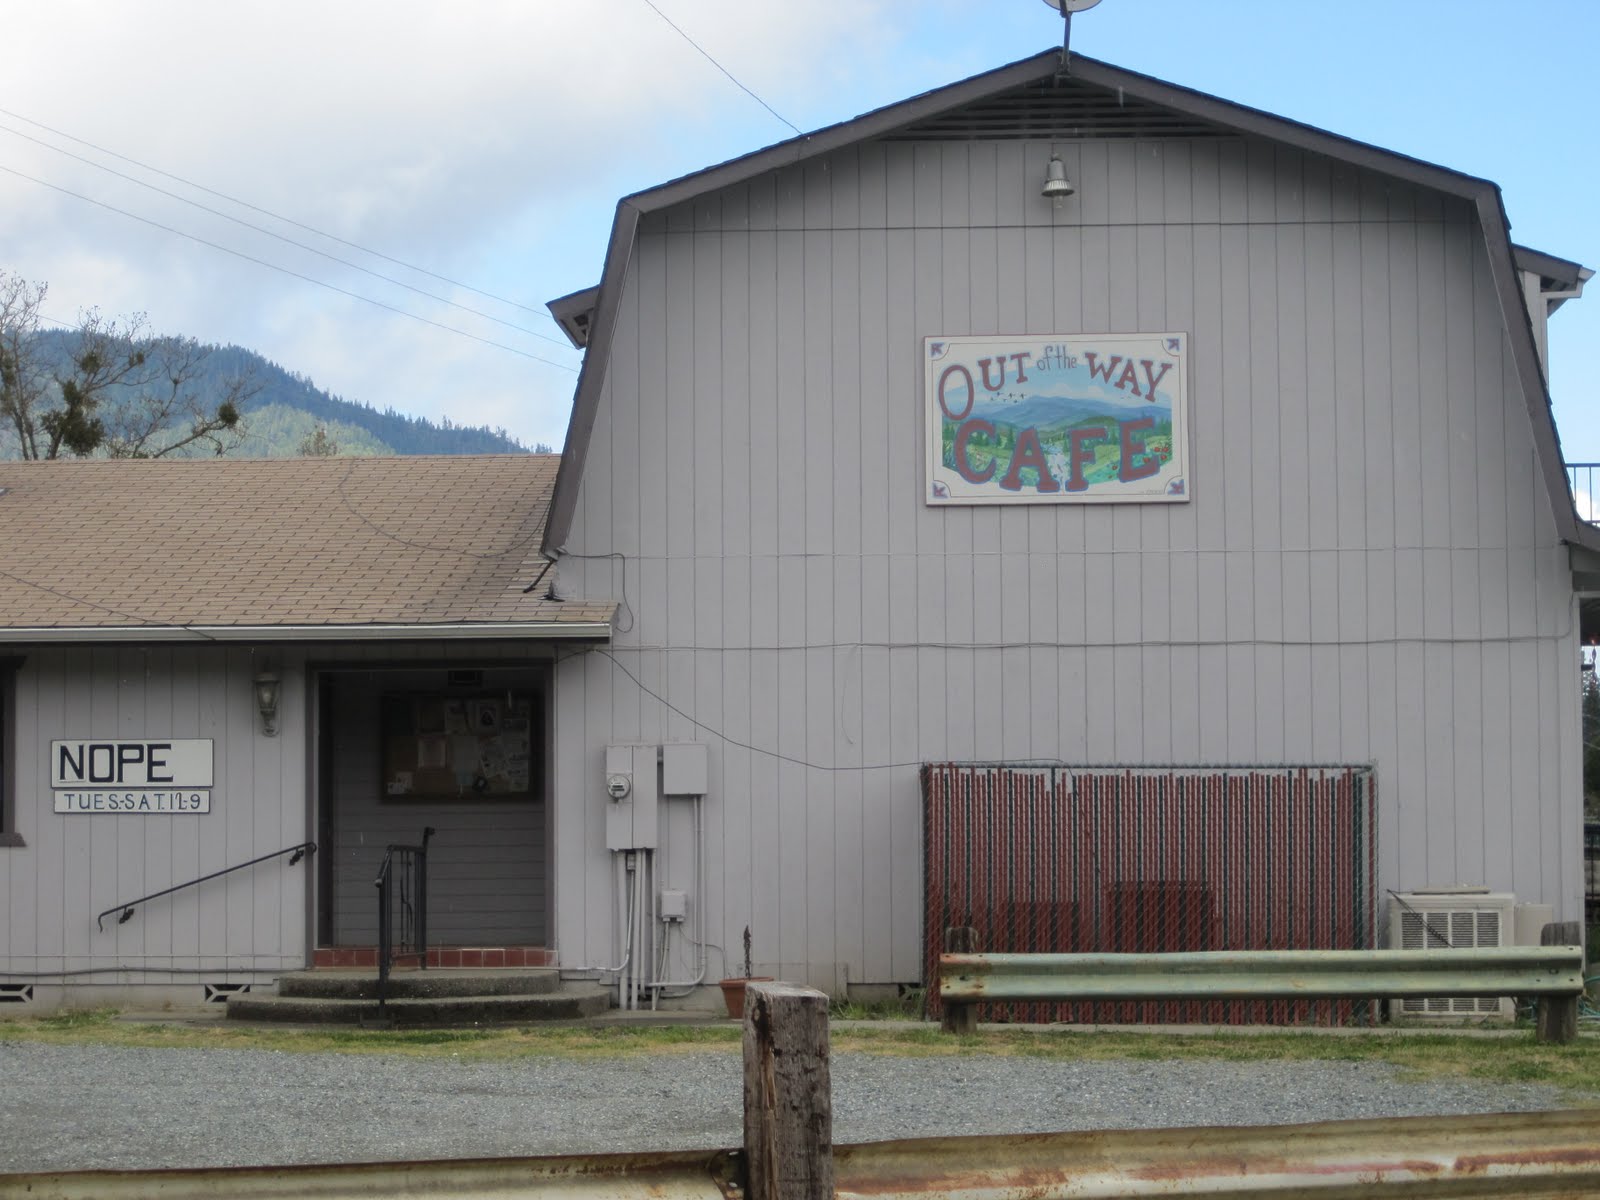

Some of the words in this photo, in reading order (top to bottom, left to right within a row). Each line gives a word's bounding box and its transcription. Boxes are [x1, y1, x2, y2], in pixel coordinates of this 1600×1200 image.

[938, 351, 1031, 421] OUT
[1036, 345, 1053, 371] of
[1054, 344, 1077, 369] the
[1084, 352, 1173, 402] WAY
[953, 418, 1162, 493] CAFE
[58, 743, 174, 783] NOPE
